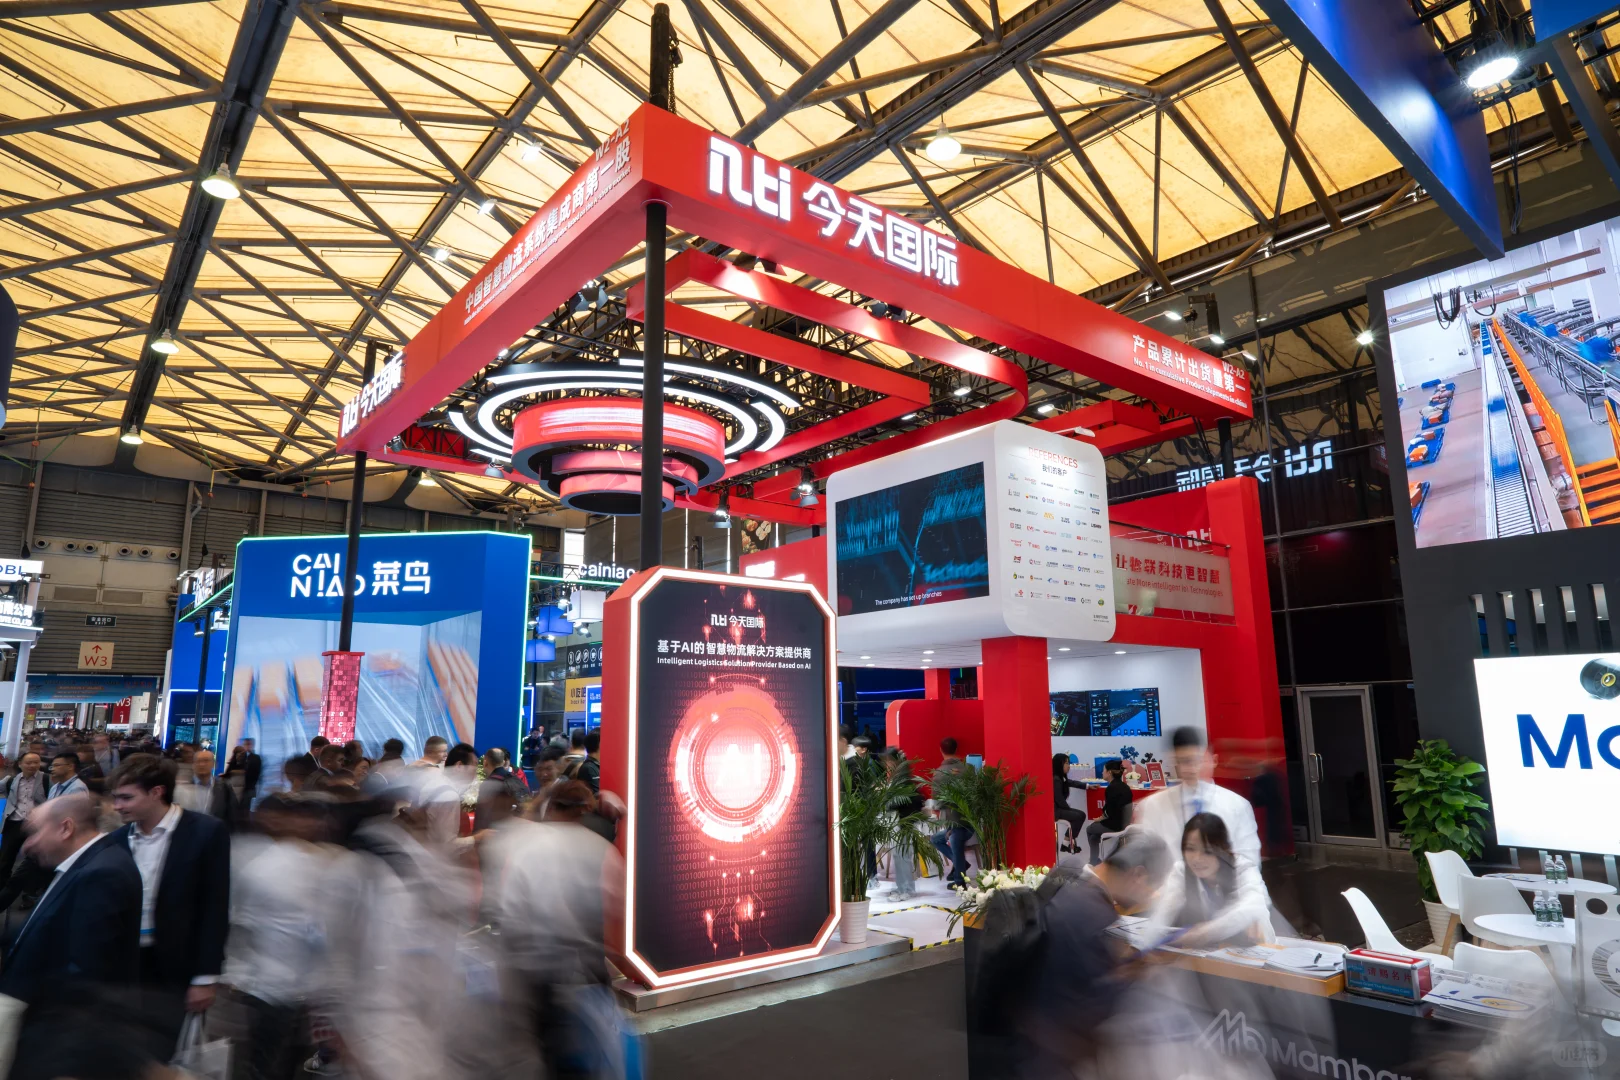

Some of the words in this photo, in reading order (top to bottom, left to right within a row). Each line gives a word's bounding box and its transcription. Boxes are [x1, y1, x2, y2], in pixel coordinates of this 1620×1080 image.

[595, 118, 631, 162] W2-A2
[465, 135, 632, 314] 中国智慧物流系统集成商第一股
[803, 181, 959, 287] 今天国际
[1132, 334, 1246, 393] 产品累计出货量第一
[1133, 357, 1144, 369] No.
[1149, 363, 1156, 372] in
[1222, 360, 1246, 380] W2-A2
[360, 351, 404, 418] 今天国际
[1028, 446, 1079, 469] REFERENCES
[1041, 463, 1068, 477] 我们的客户
[371, 560, 431, 596] 菜鸟
[1116, 553, 1220, 585] 让物联科技更智慧
[728, 615, 764, 629] 今天国际
[84, 655, 108, 667] W3
[657, 657, 694, 667] Intelligent
[694, 657, 723, 668] Logistics
[723, 659, 751, 668] Solution
[751, 660, 777, 669] Provider
[115, 697, 131, 707] W3
